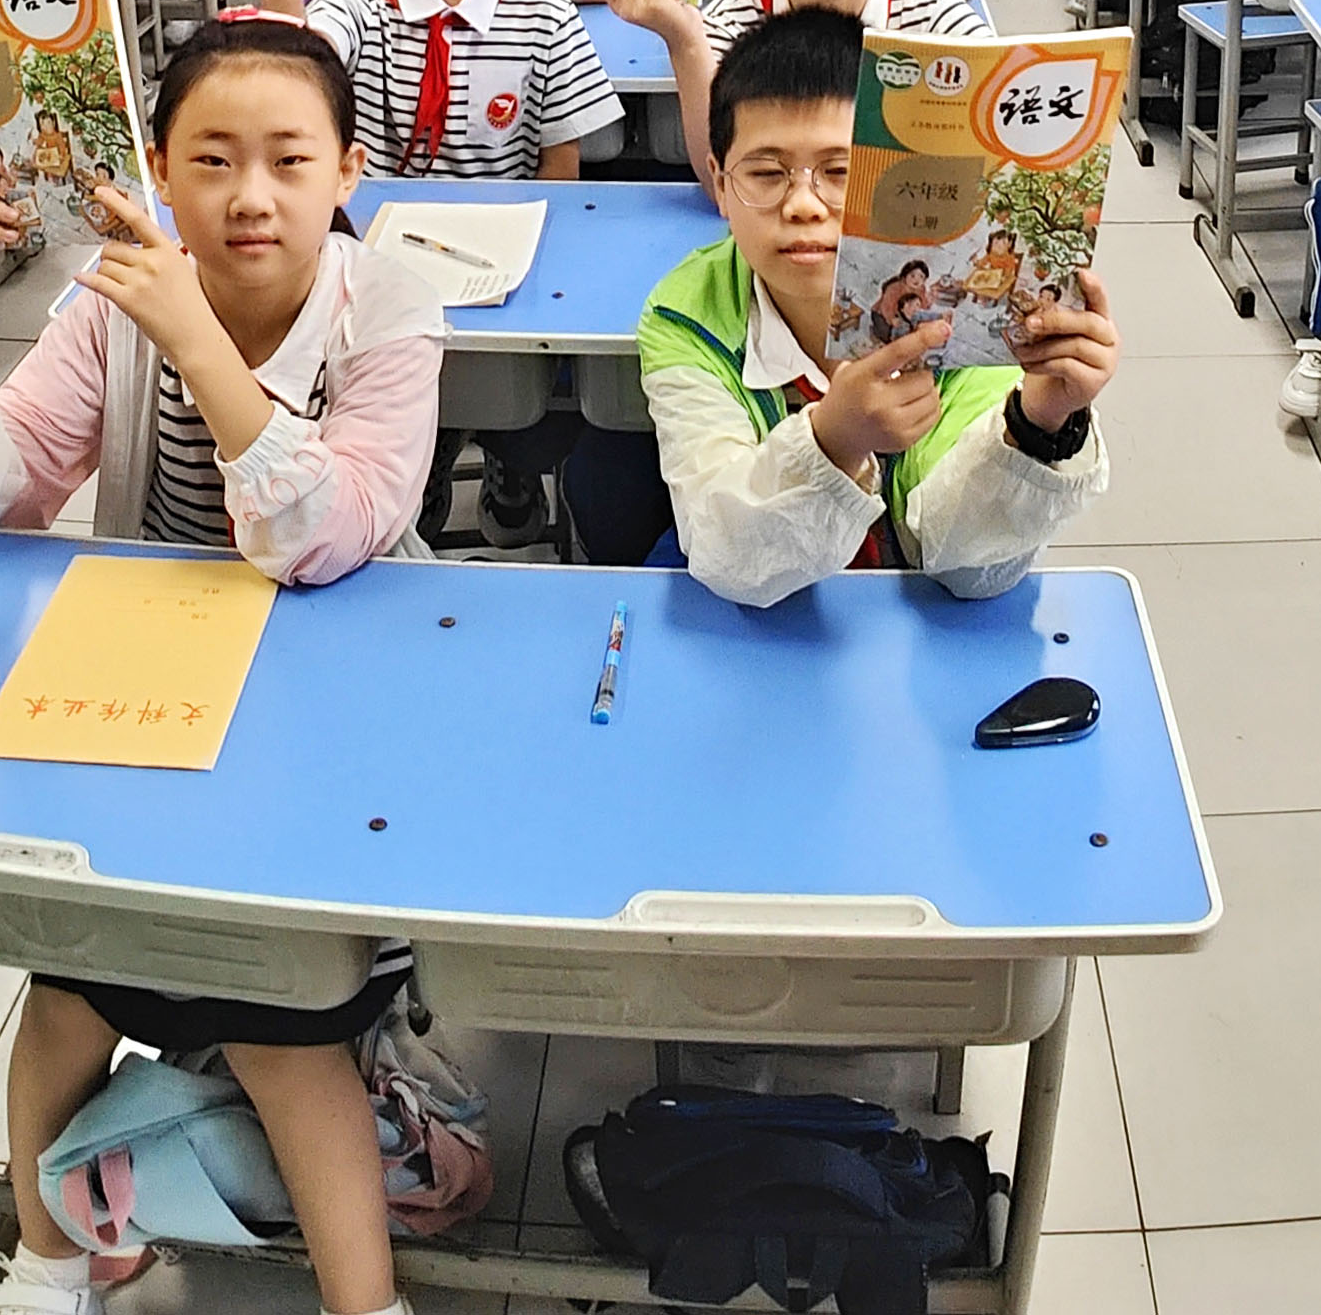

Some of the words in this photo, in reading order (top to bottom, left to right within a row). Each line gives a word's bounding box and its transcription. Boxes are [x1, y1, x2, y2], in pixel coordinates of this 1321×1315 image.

[998, 85, 1085, 126] 语文
[895, 181, 959, 201] 六年级
[910, 215, 938, 230] 上册
[24, 694, 209, 725] 文科作业本
